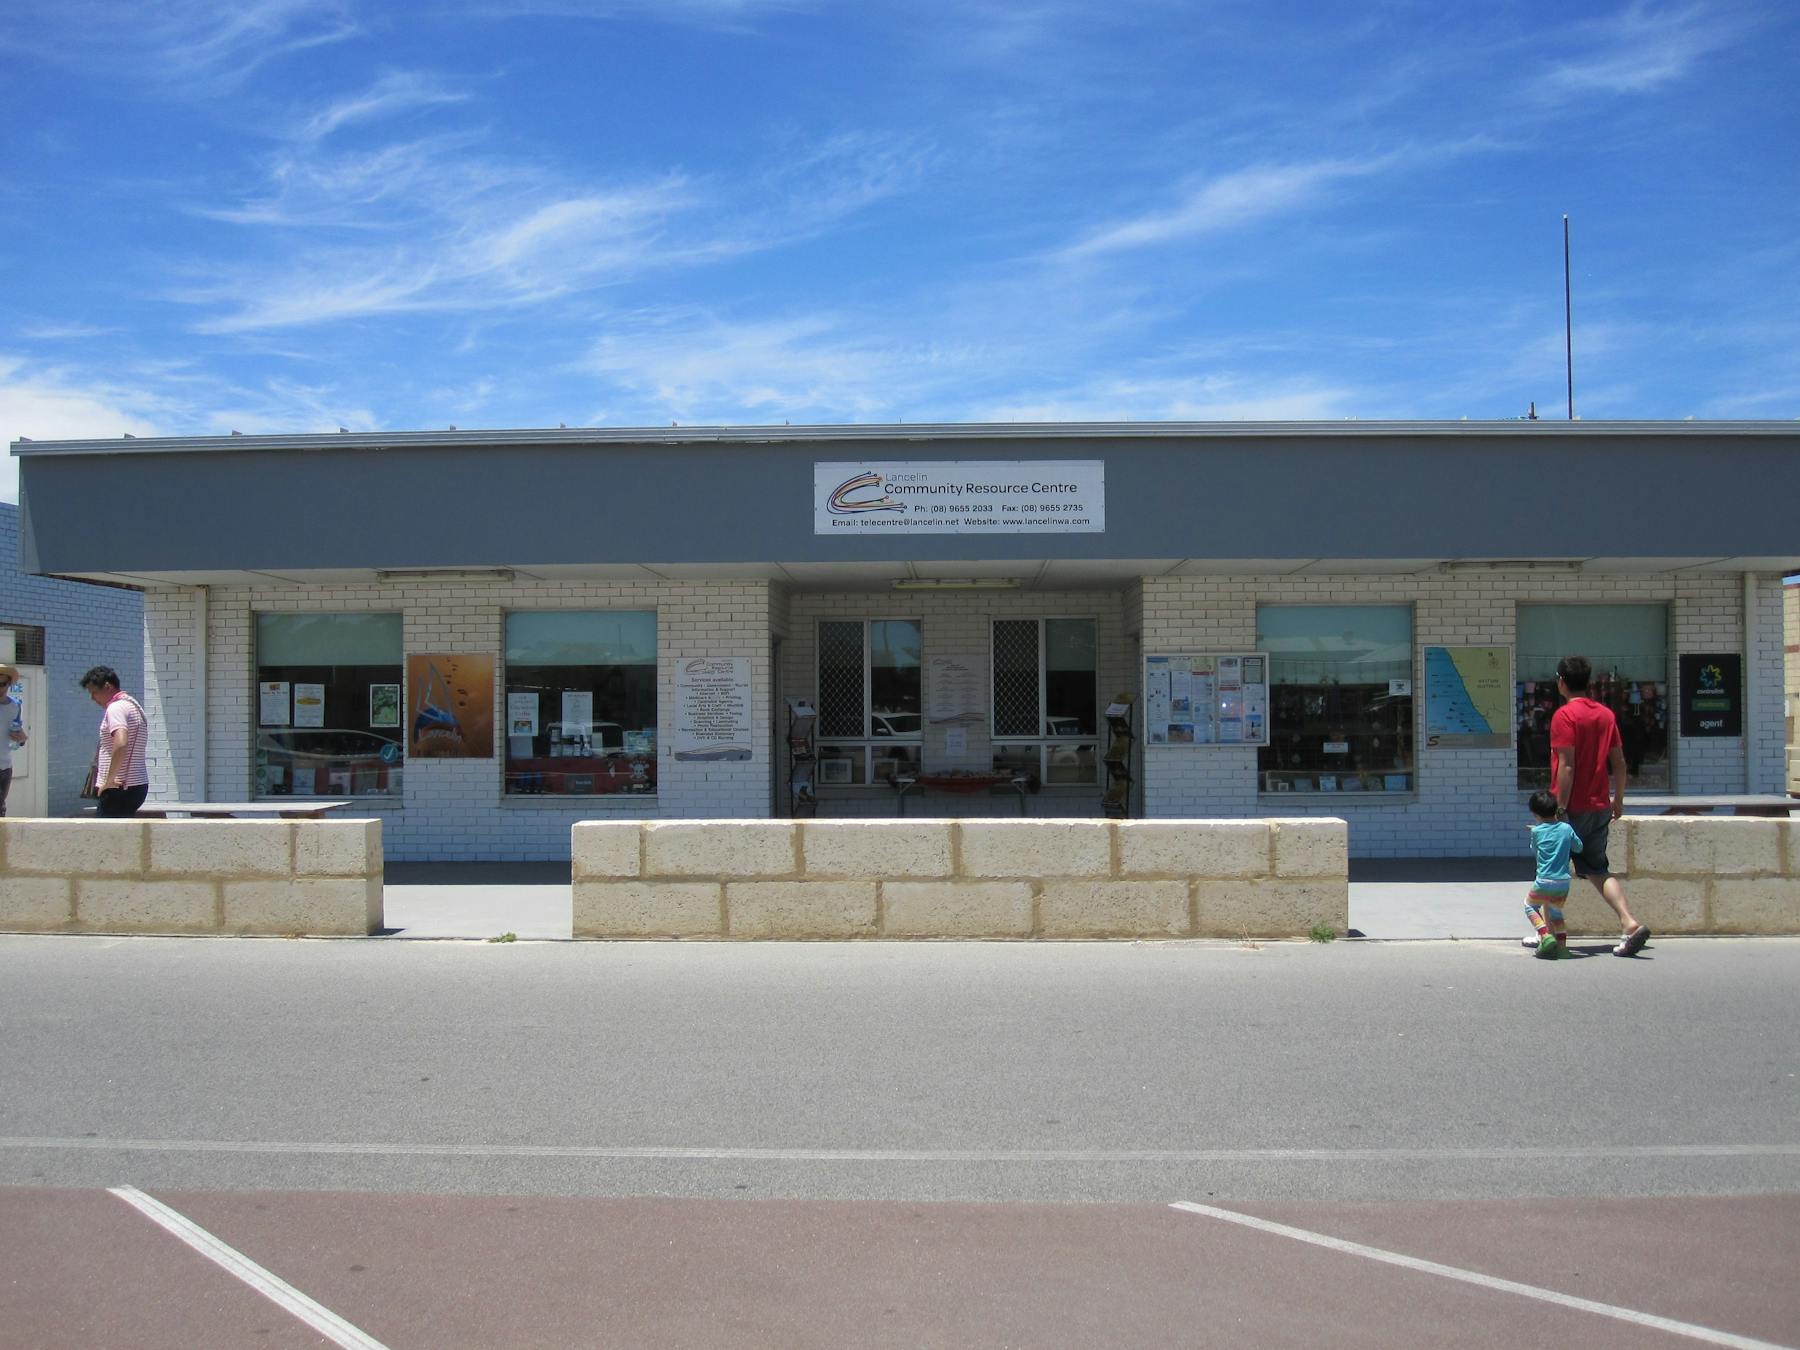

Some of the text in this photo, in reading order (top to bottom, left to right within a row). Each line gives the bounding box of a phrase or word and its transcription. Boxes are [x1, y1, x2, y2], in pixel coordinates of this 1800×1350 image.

[885, 473, 928, 482] Lancelin
[884, 482, 1078, 496] Community Resource Centre
[914, 503, 1084, 513] Ph: (08) 9655 2033 Fax: (08) 9655 2735
[832, 517, 1090, 527] Email: telecentre@lancelin.net Website: www.lancelinwa.com
[1699, 719, 1724, 730] agent
